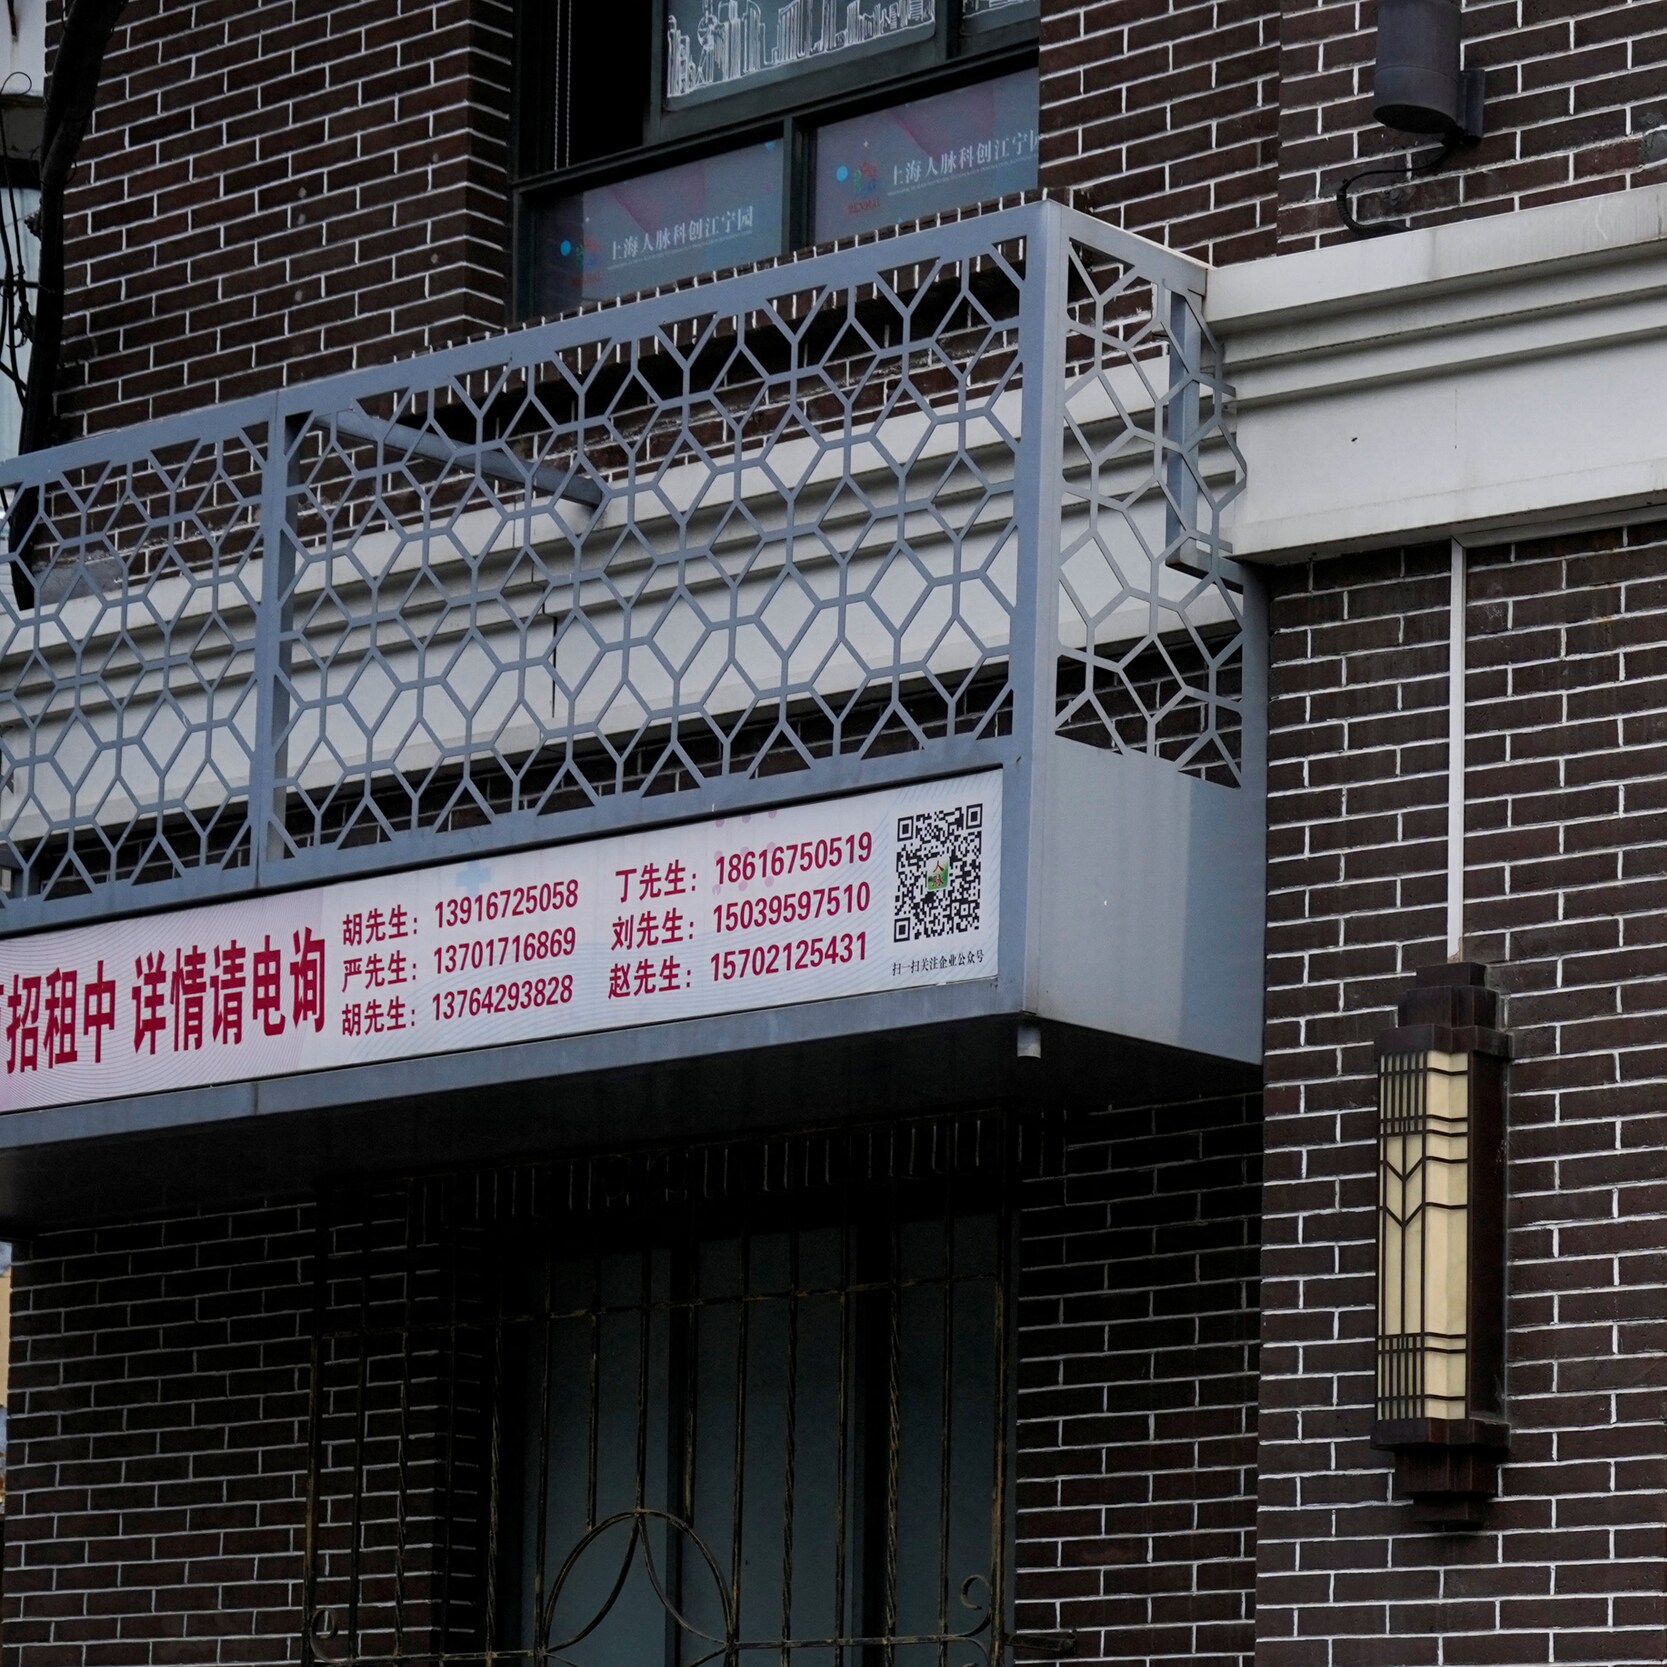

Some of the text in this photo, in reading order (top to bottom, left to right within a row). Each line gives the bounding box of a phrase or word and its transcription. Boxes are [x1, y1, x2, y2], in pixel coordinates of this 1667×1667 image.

[715, 831, 872, 885] 18616750519
[434, 879, 579, 928] 13916725058
[713, 881, 871, 933] 15039597510
[433, 926, 577, 974] 13701716869
[710, 931, 867, 982] 15702125431
[892, 949, 985, 976] 扫一扫关注企业公众号
[0, 926, 326, 1074] 招租中 详情请电询
[432, 974, 574, 1021] 13764293828
